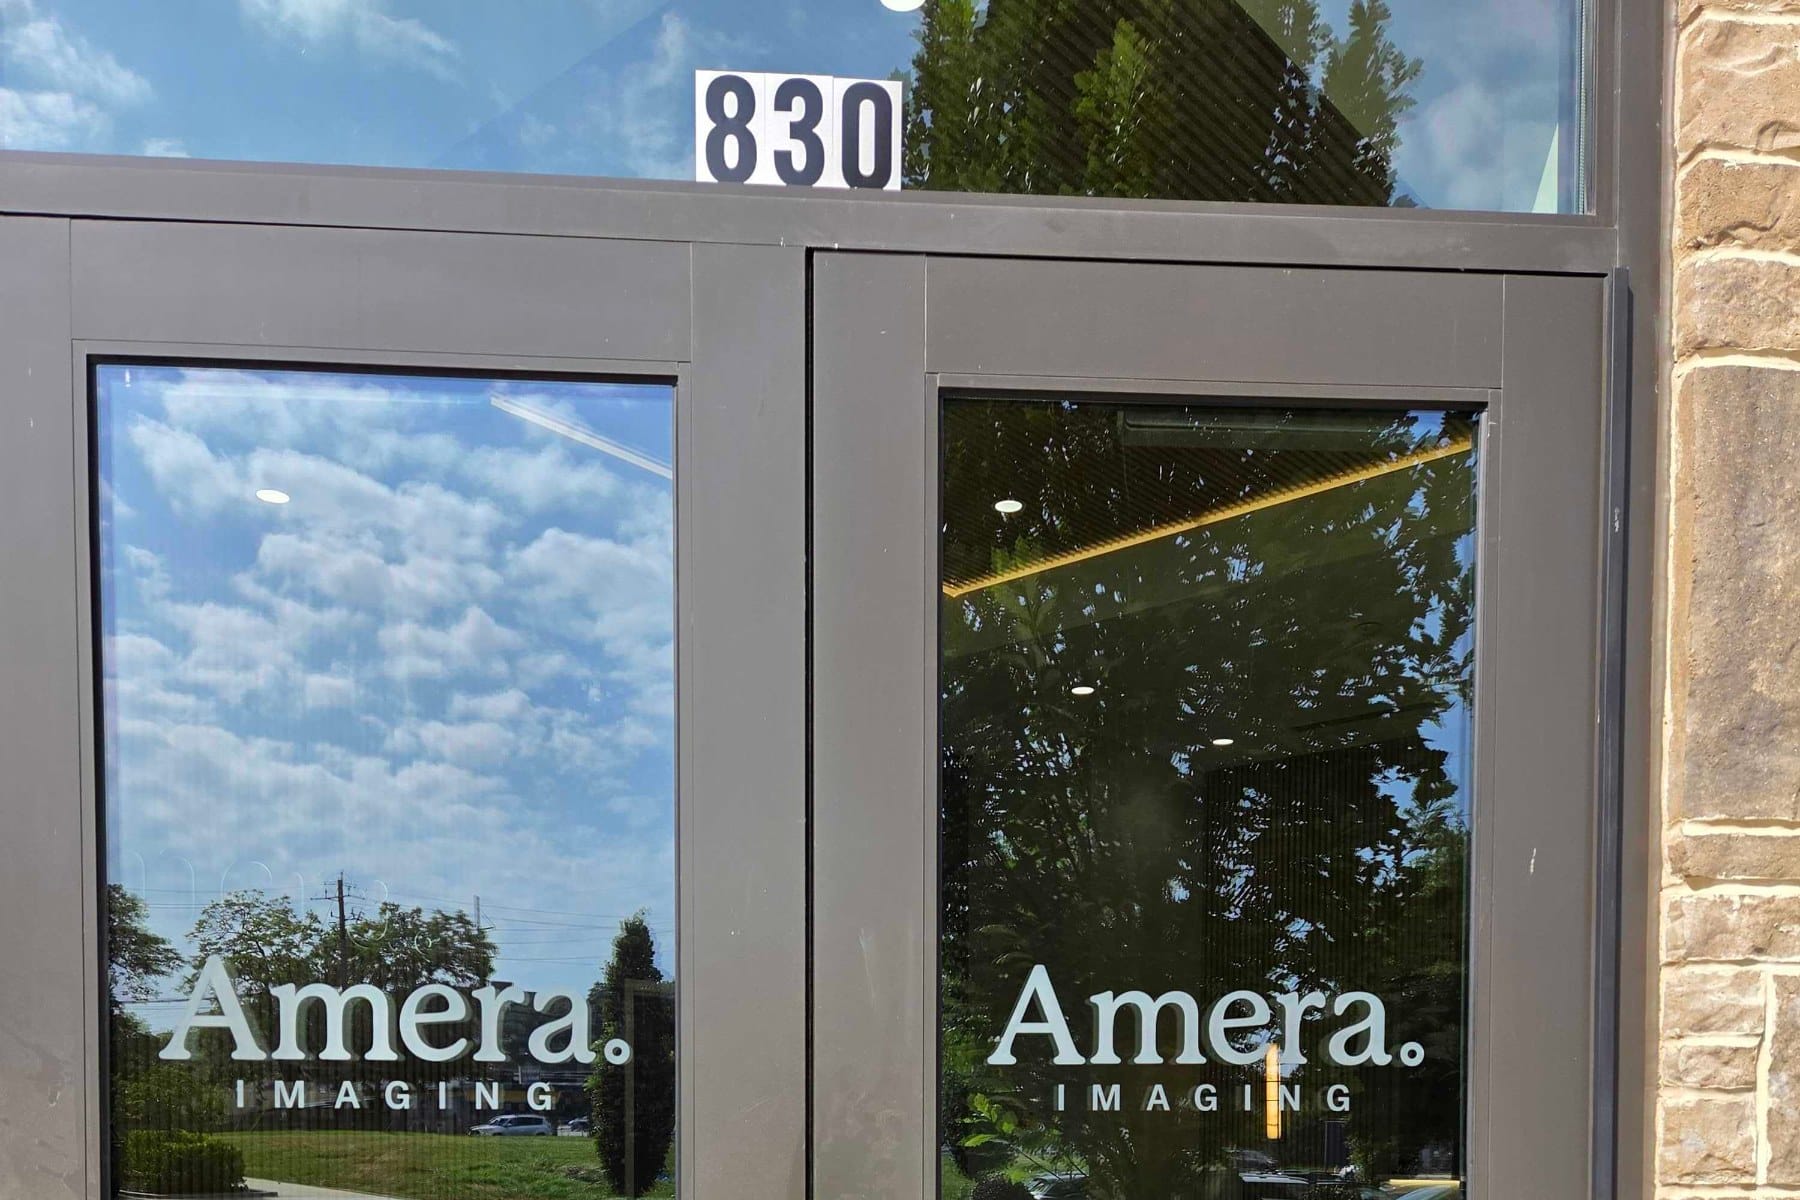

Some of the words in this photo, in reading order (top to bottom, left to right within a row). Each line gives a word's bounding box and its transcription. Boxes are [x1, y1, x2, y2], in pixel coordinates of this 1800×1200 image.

[705, 74, 893, 189] 830
[236, 1079, 553, 1111] IMAGING
[1057, 1083, 1351, 1112] IMAGING
